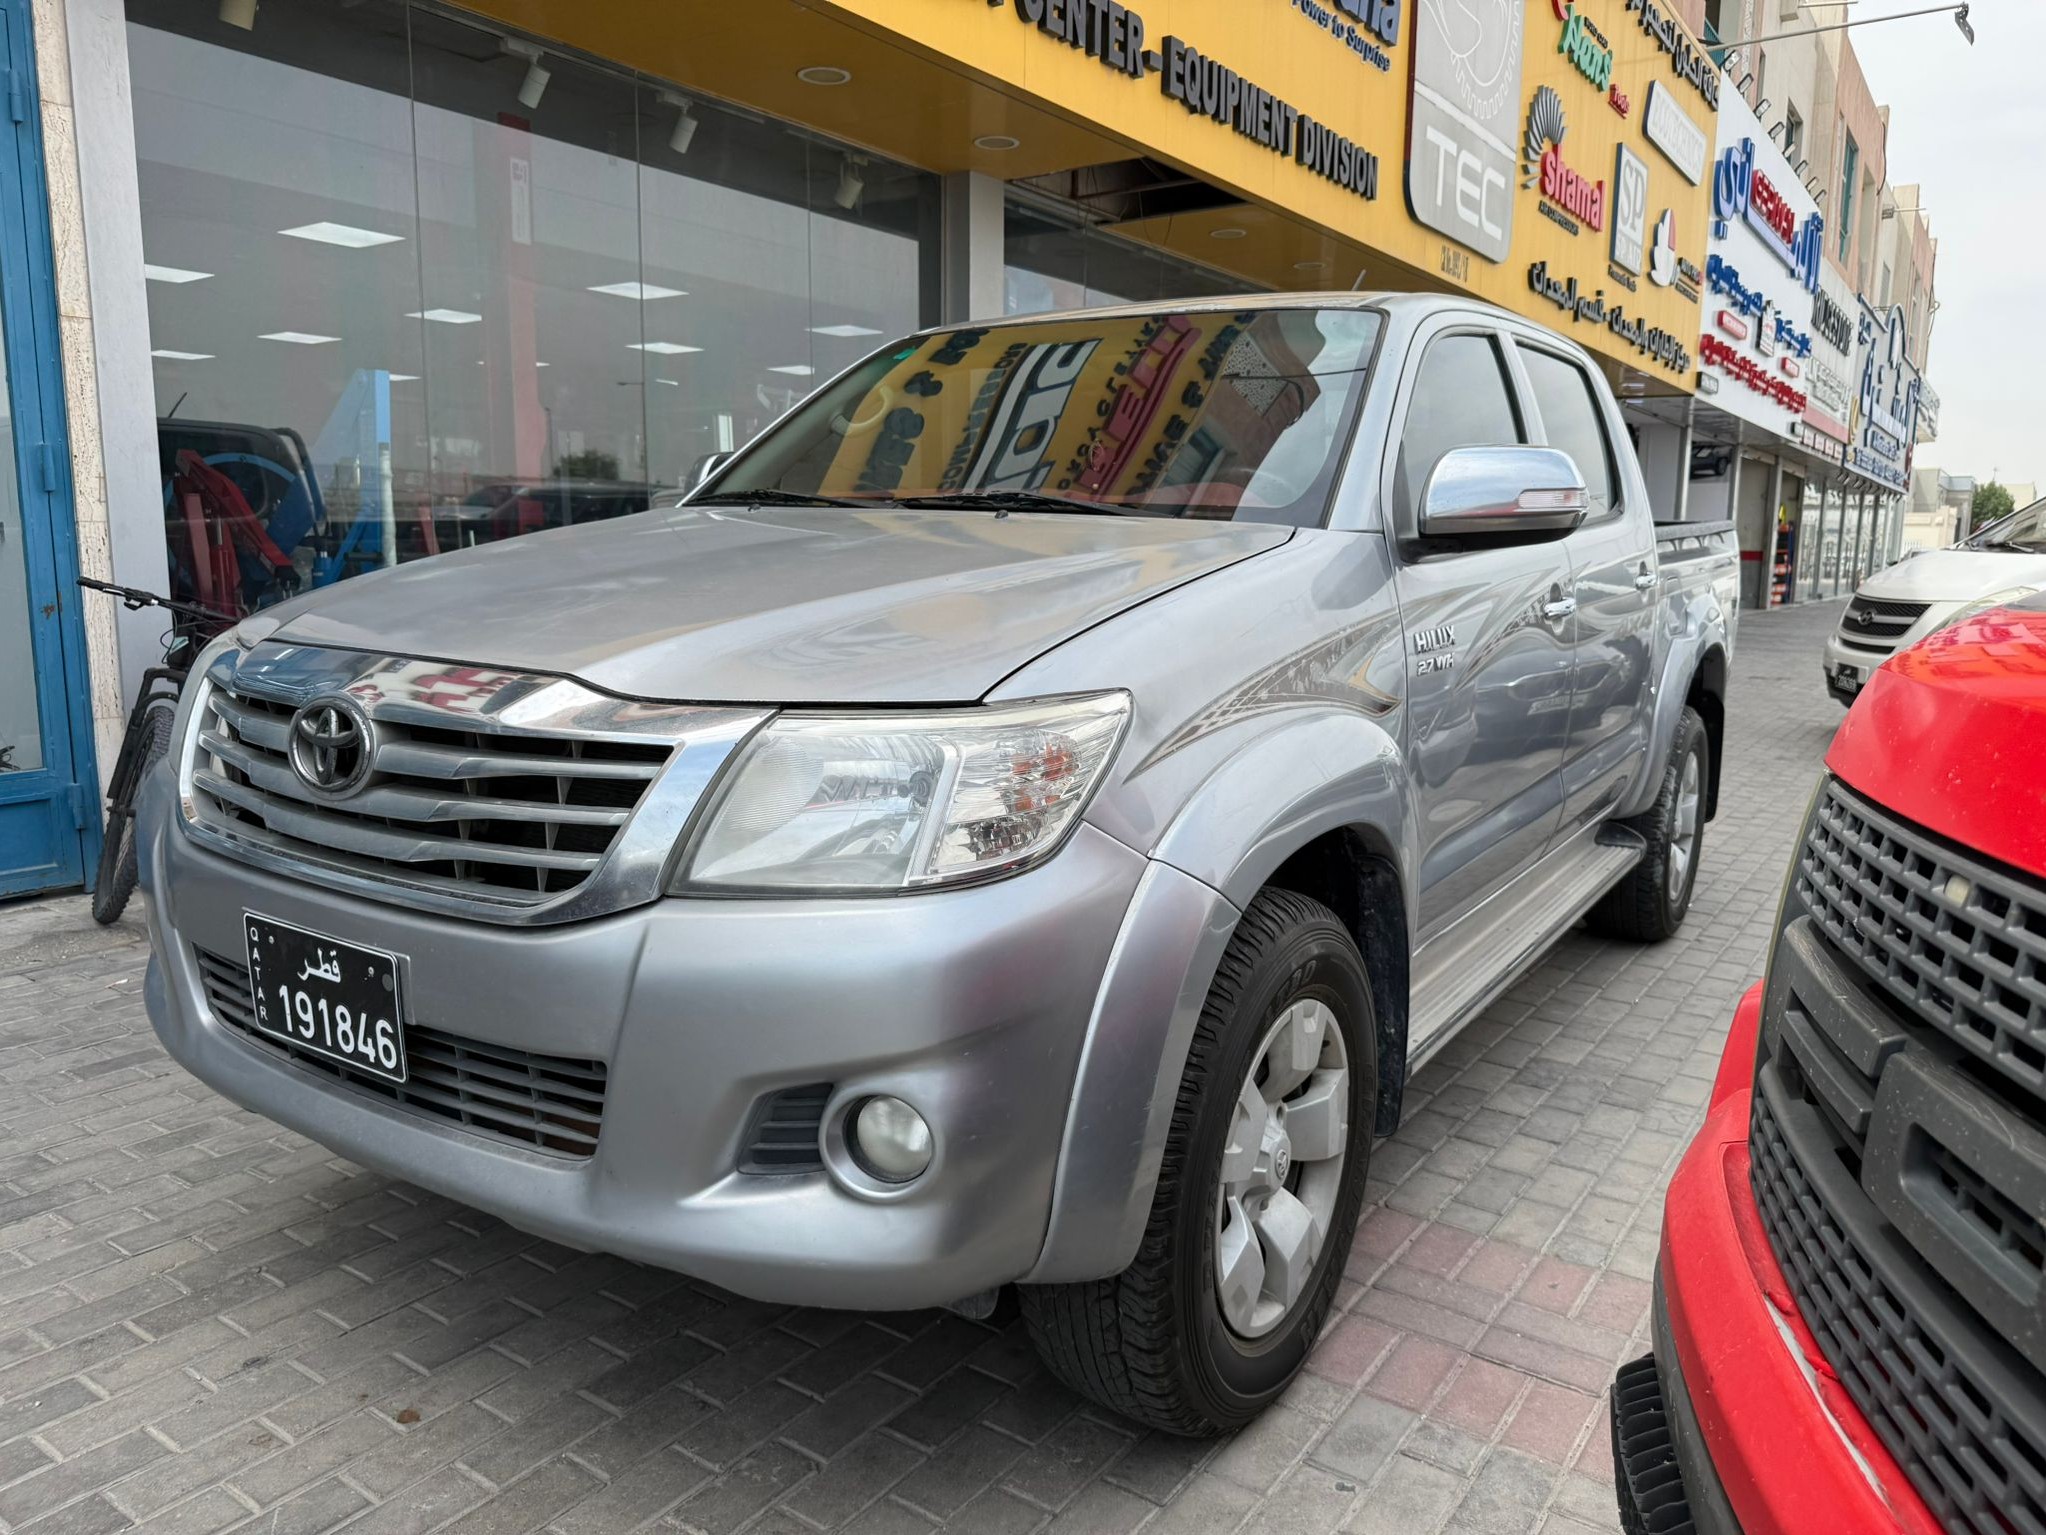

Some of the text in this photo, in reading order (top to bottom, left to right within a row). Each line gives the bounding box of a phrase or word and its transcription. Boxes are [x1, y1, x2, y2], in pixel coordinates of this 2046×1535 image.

[1346, 26, 1390, 72] Surprise
[1161, 35, 1297, 158] EQUIPMENT
[1296, 114, 1379, 200] DIVISION
[1427, 125, 1506, 241] TEC
[1620, 158, 1645, 232] SP
[1413, 625, 1455, 655] HILUX
[250, 927, 268, 1021] QATAR
[297, 947, 342, 983] قطر
[279, 985, 397, 1069] 191846
